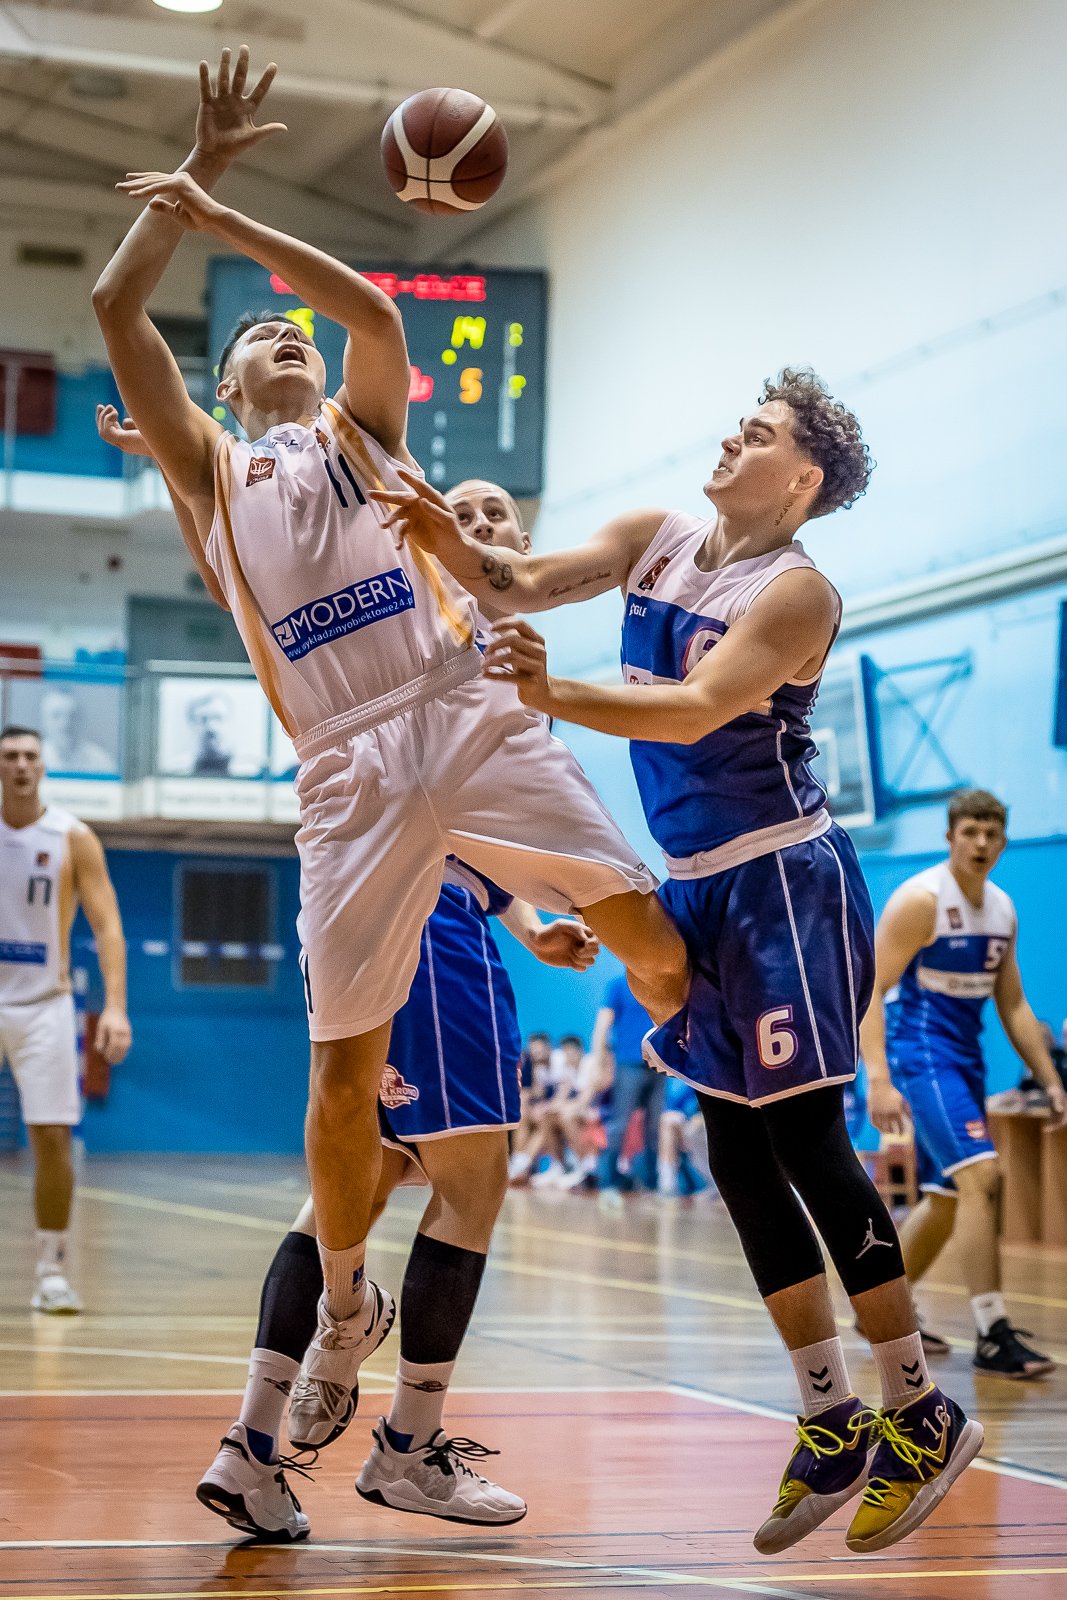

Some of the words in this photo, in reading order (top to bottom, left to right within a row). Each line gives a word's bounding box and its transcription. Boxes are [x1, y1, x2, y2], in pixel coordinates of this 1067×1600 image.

[324, 453, 367, 508] 11
[290, 571, 410, 640] MODERN
[756, 1004, 798, 1069] 6
